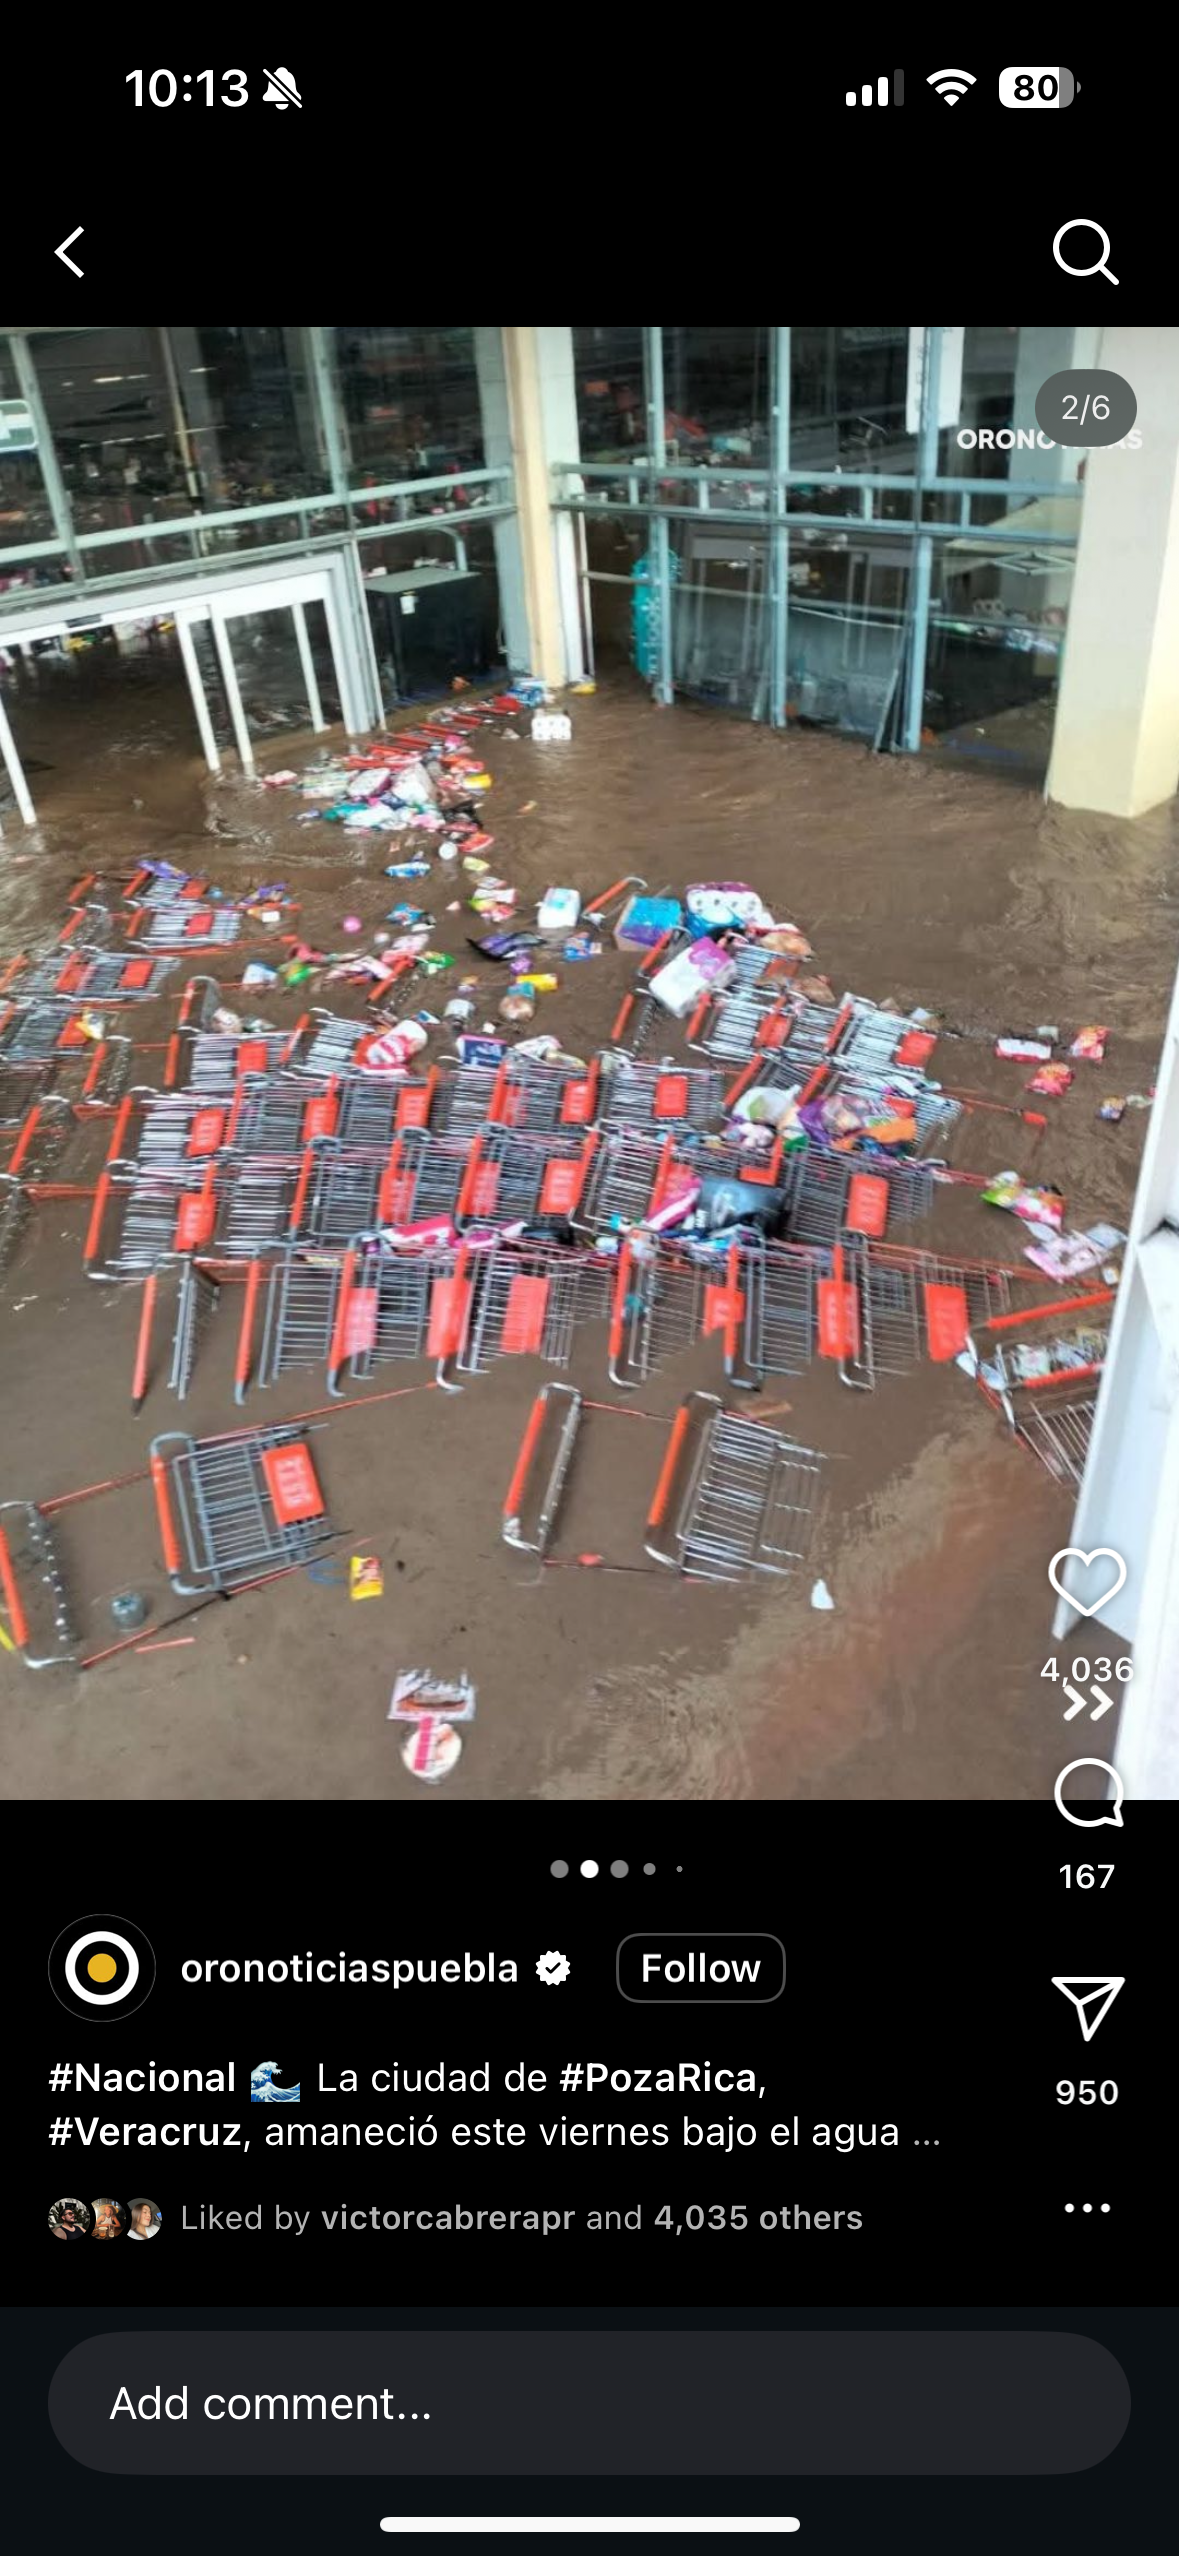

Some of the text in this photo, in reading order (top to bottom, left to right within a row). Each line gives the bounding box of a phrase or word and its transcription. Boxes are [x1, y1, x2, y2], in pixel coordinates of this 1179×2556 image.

[125, 68, 249, 108] 10:13
[1013, 74, 1059, 101] 80
[1040, 1656, 1134, 1688] 4,036
[1059, 1863, 1115, 1890] 167
[181, 1950, 518, 1990] oronoticiaspuebla
[642, 1952, 762, 1983] Follow
[48, 2060, 766, 2099] #Nacional La ciudad de #PozaRica,
[1055, 2079, 1119, 2106] 950
[48, 2116, 251, 2153] #Veracruz,
[265, 2114, 438, 2146] amaneció
[451, 2118, 526, 2146] este
[539, 2115, 669, 2146] viernes
[683, 2115, 757, 2153] bajo
[770, 2115, 799, 2146] el
[812, 2123, 899, 2153] agua
[182, 2203, 863, 2236] Liked by victorcabrerapr and 4,035 others
[109, 2385, 431, 2421] Add comment...
